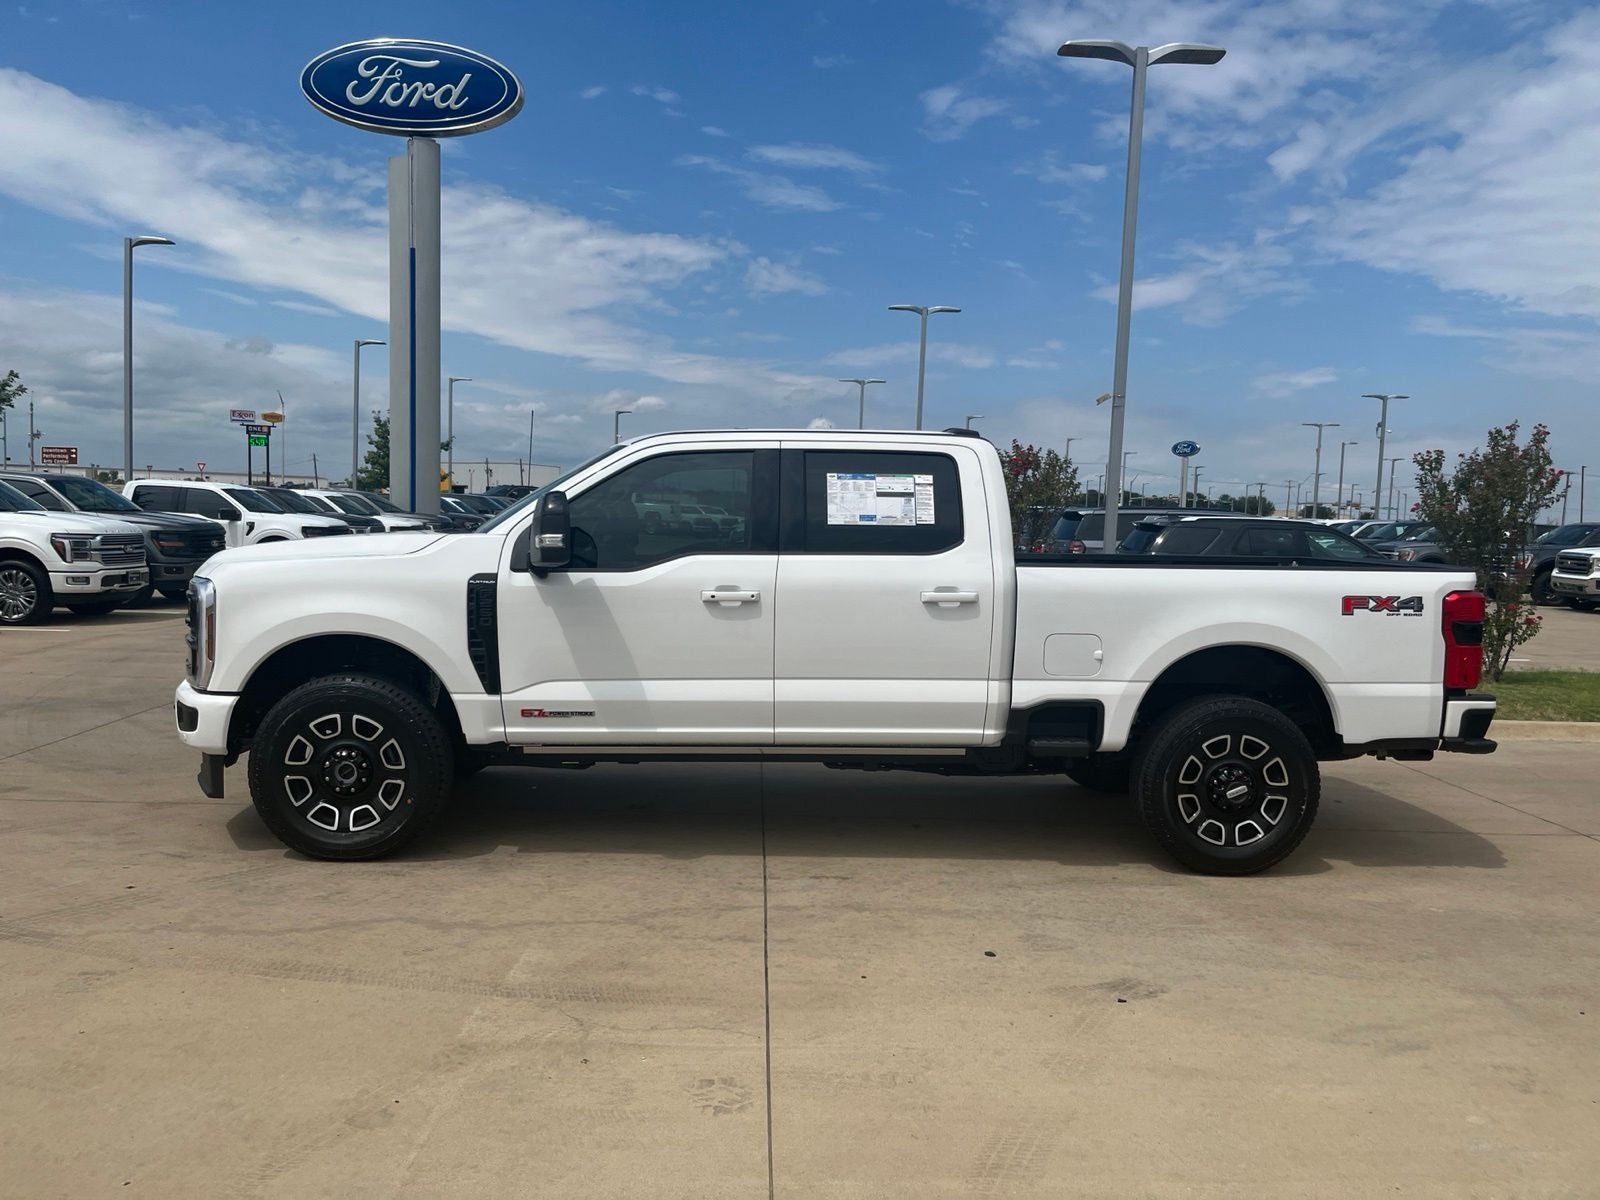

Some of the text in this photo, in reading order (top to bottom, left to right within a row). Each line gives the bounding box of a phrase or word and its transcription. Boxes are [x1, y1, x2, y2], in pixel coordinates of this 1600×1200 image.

[345, 55, 473, 111] Ford
[232, 410, 254, 419] Exxon
[1176, 444, 1192, 454] Ford
[1342, 596, 1424, 615] FX4
